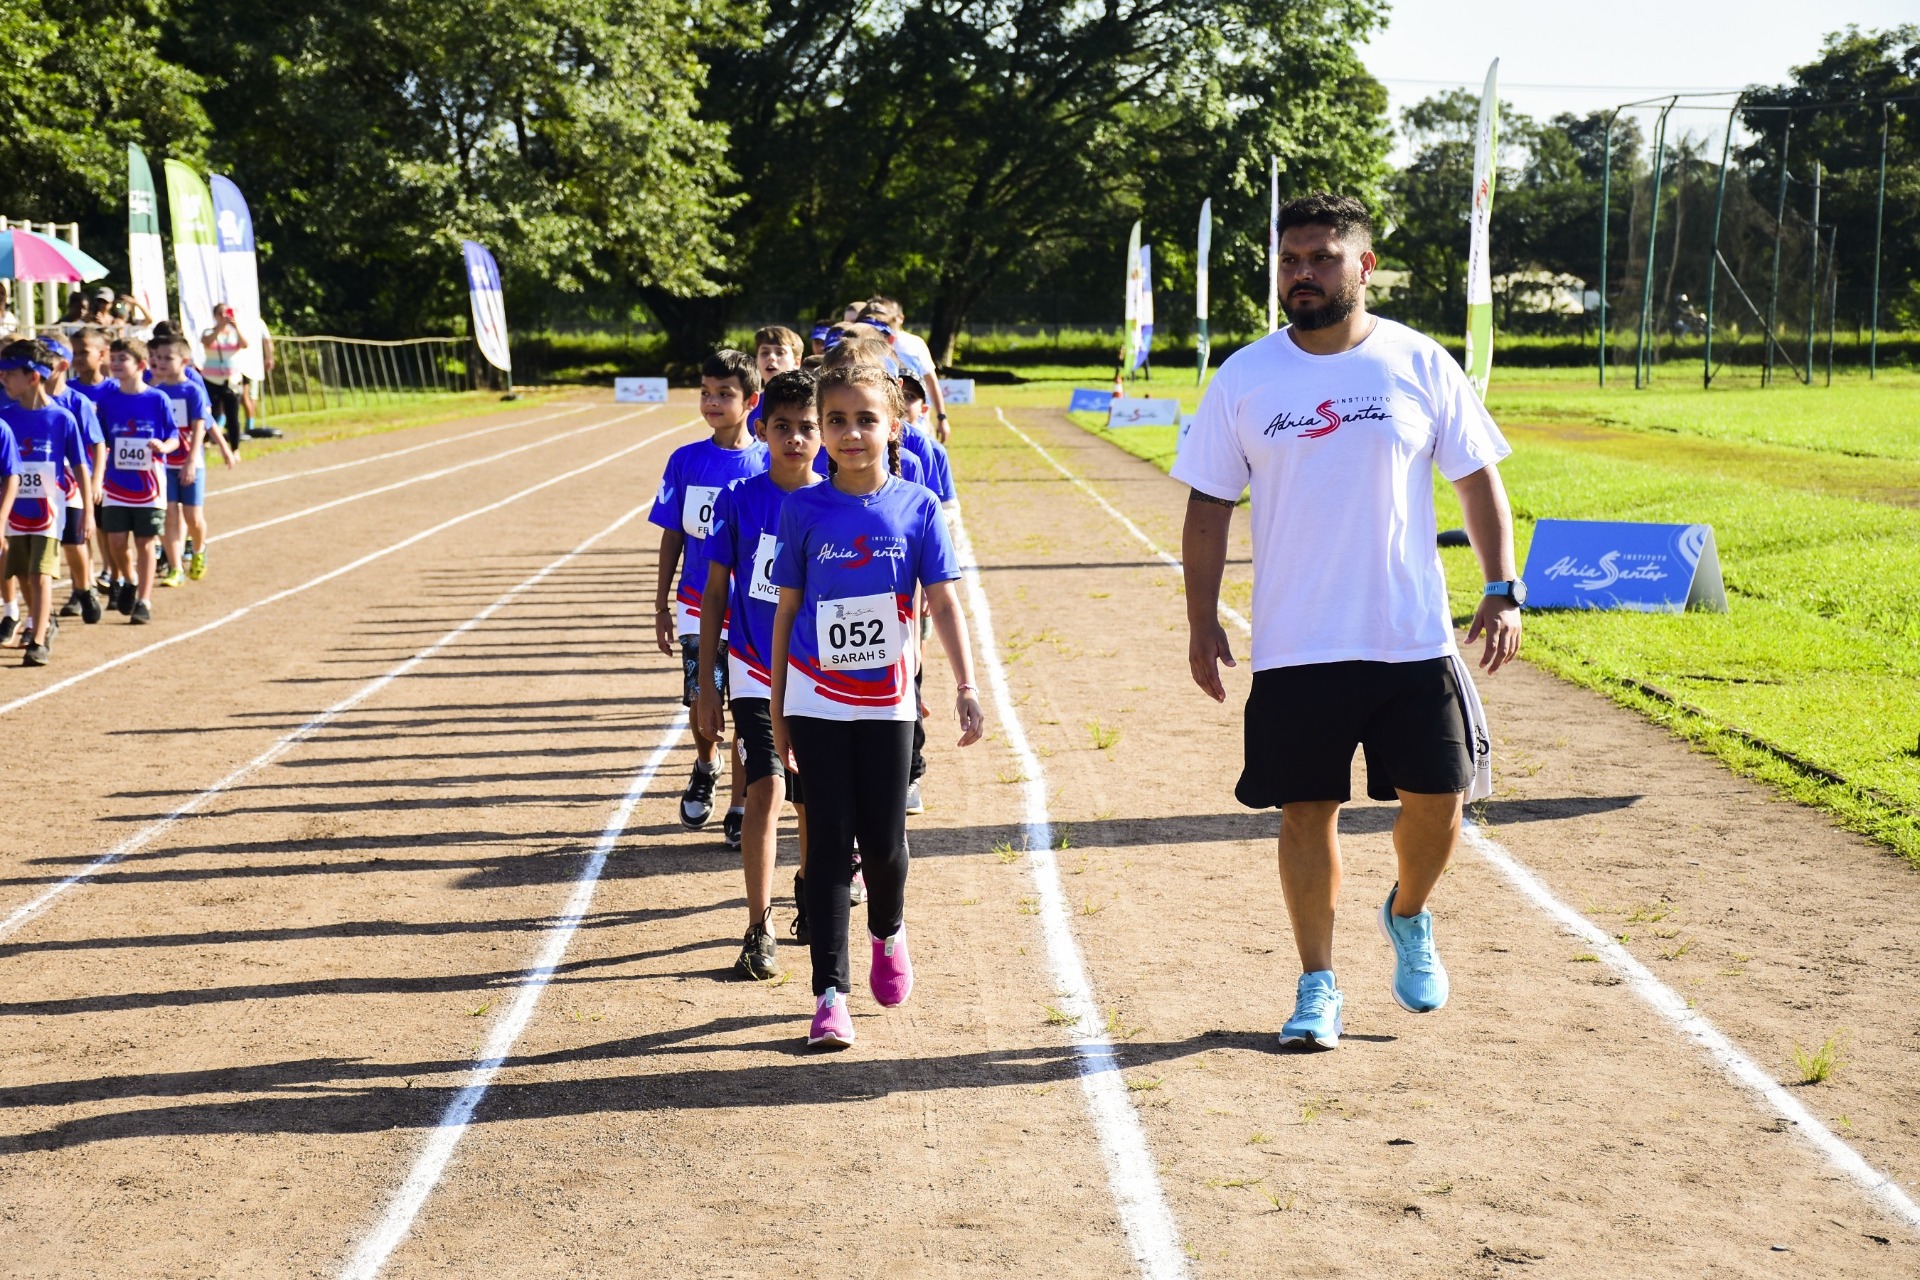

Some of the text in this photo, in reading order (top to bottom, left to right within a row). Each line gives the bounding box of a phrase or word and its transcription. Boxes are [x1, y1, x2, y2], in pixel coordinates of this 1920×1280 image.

[1336, 396, 1391, 404] INSTITUTO
[1263, 399, 1392, 439] Adria Santos
[119, 448, 145, 461] 040
[817, 542, 858, 564] Adria
[1623, 554, 1667, 562] INSTITUTO
[1544, 555, 1602, 581] Adria
[829, 618, 886, 650] 052
[832, 649, 886, 664] SARAH S
